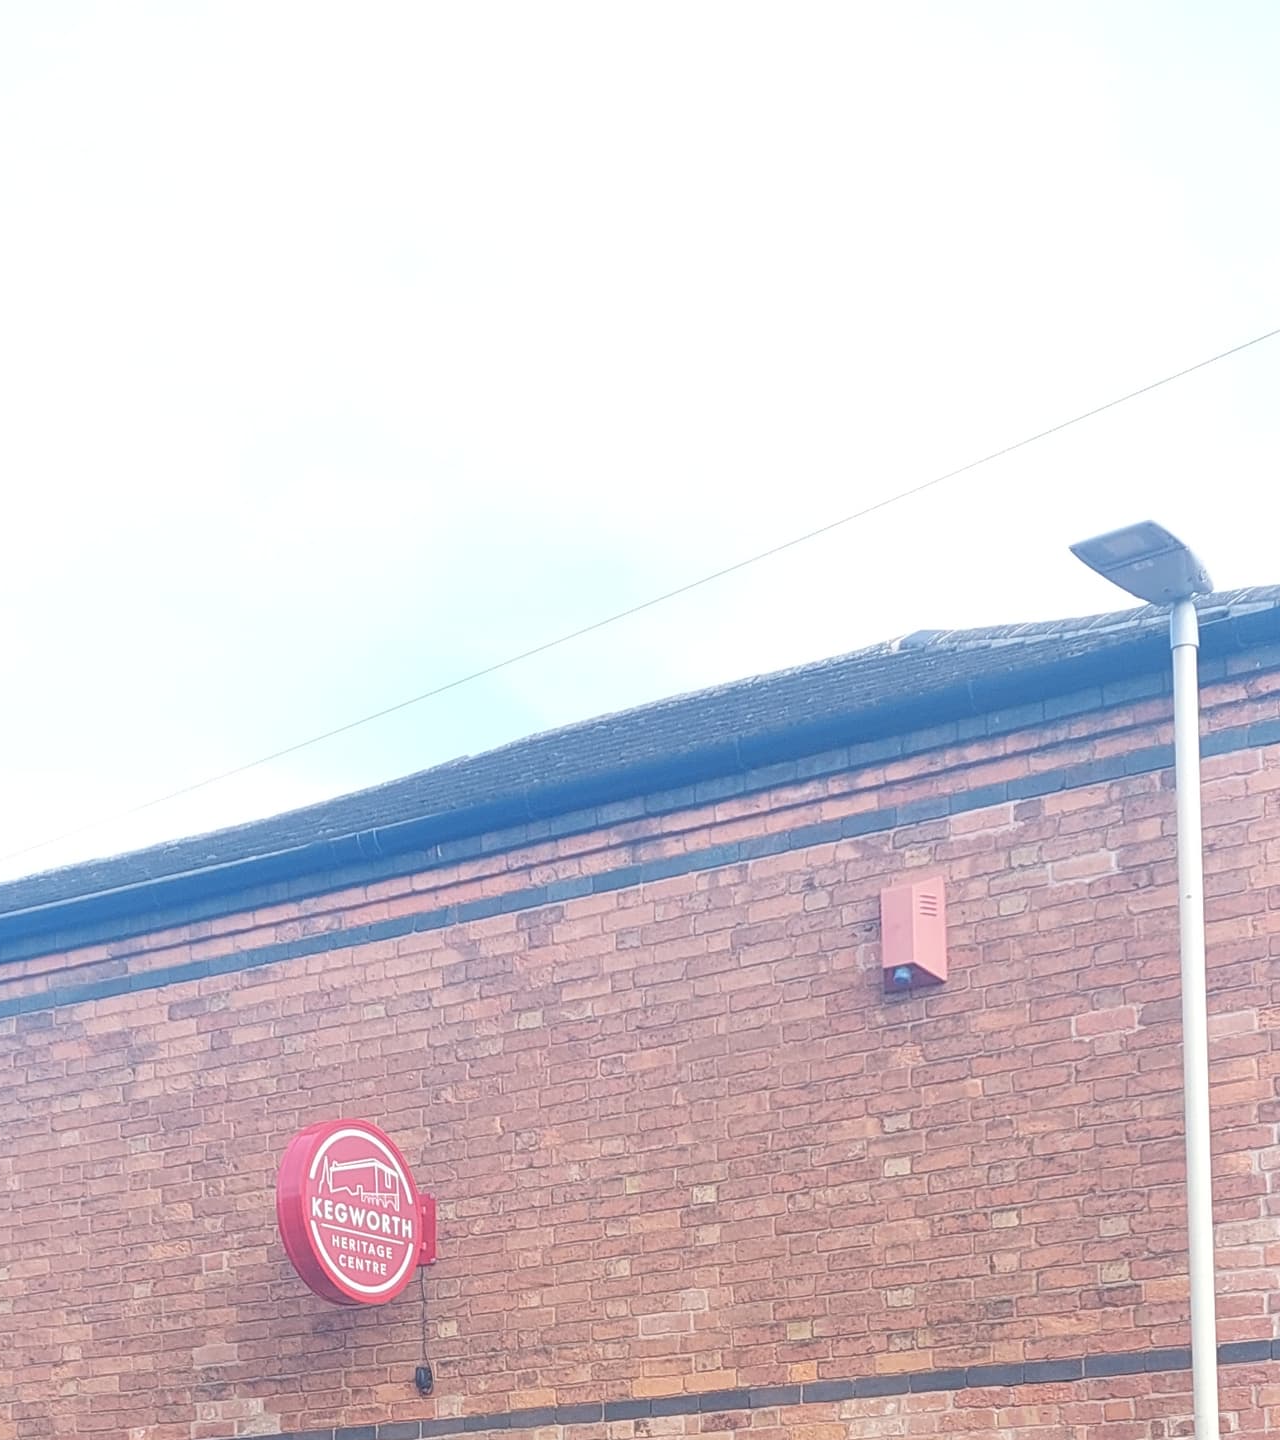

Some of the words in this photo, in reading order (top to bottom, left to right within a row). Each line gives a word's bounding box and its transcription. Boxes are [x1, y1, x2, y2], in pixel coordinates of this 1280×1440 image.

[311, 1196, 413, 1239] KEGWORTH
[331, 1235, 393, 1259] HERITAGE
[338, 1255, 387, 1276] CENTRE
